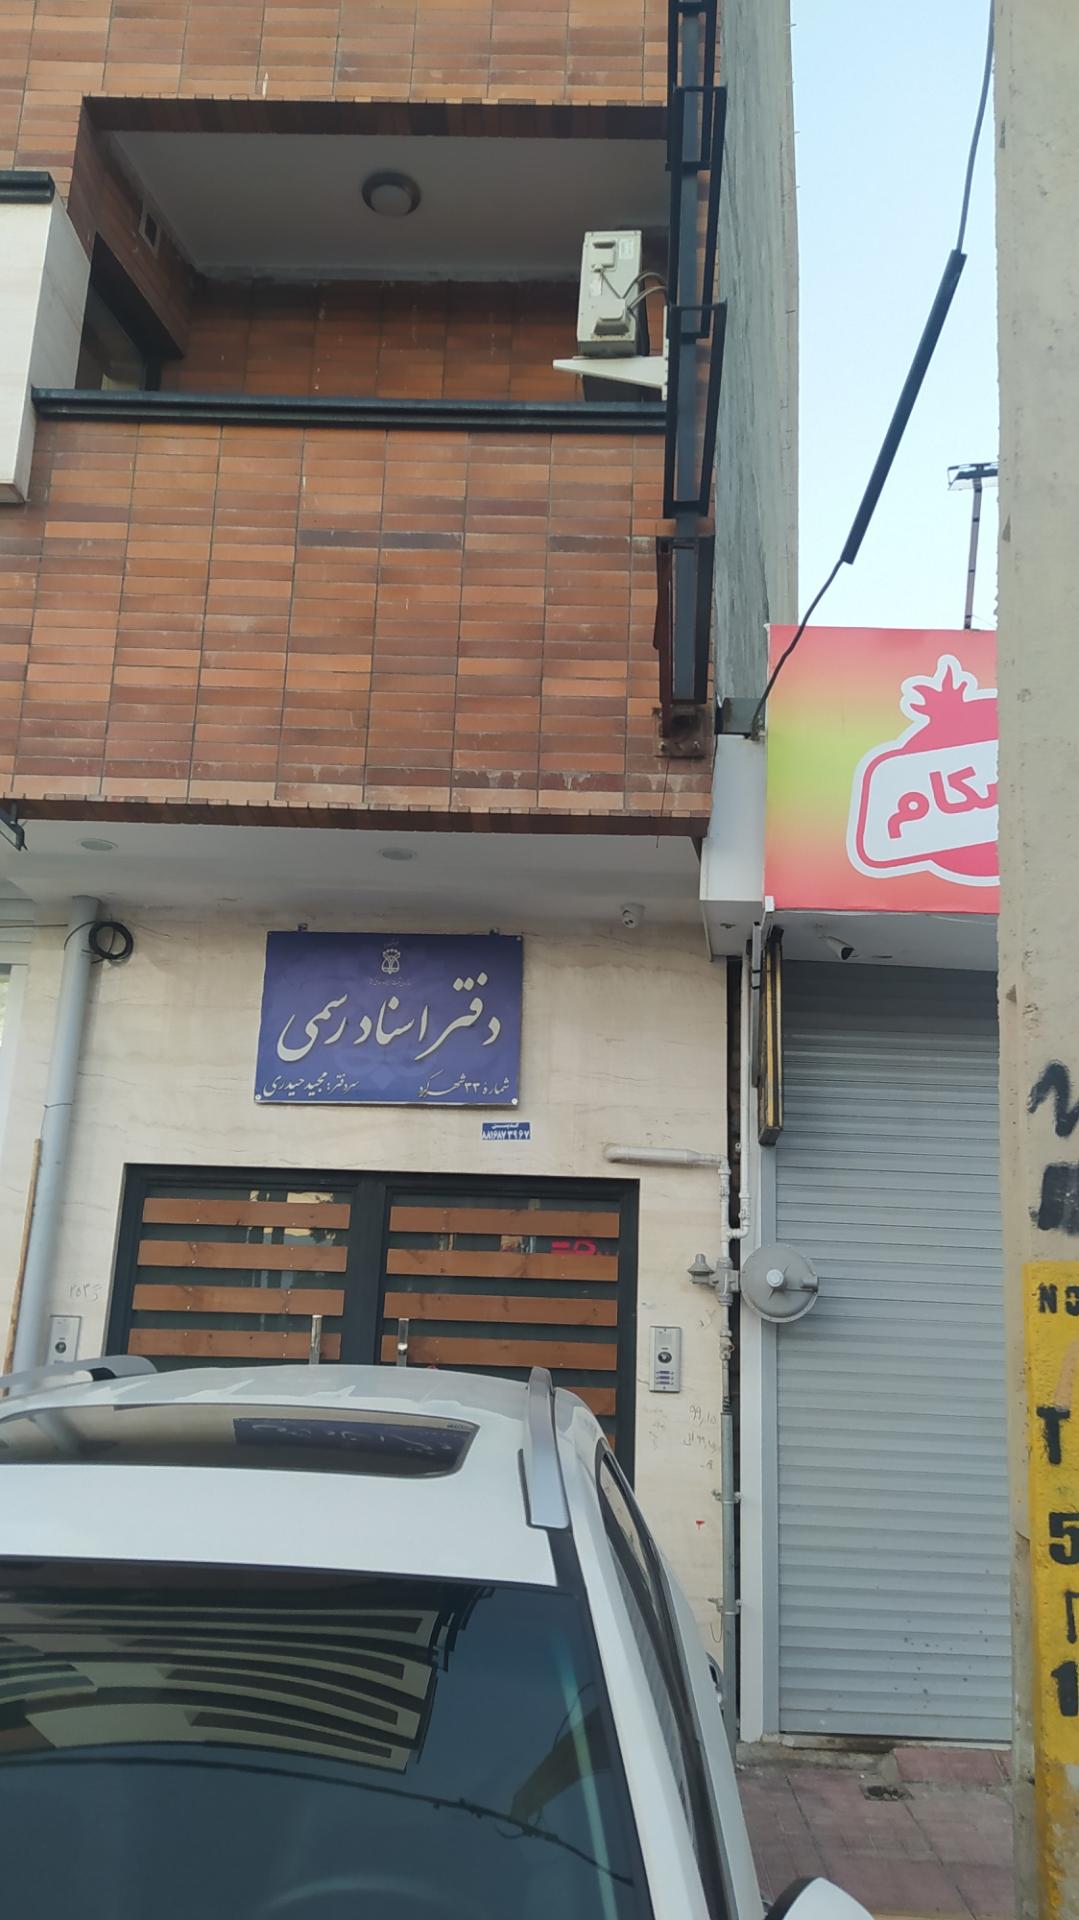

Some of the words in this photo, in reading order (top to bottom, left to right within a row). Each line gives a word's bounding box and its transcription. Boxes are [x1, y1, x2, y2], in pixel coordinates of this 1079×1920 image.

[276, 993, 348, 1062] رسمی
[352, 995, 428, 1046] اسناد
[414, 971, 501, 1061] دفتر
[262, 1074, 305, 1097] حیدری
[303, 1071, 328, 1097] مجید
